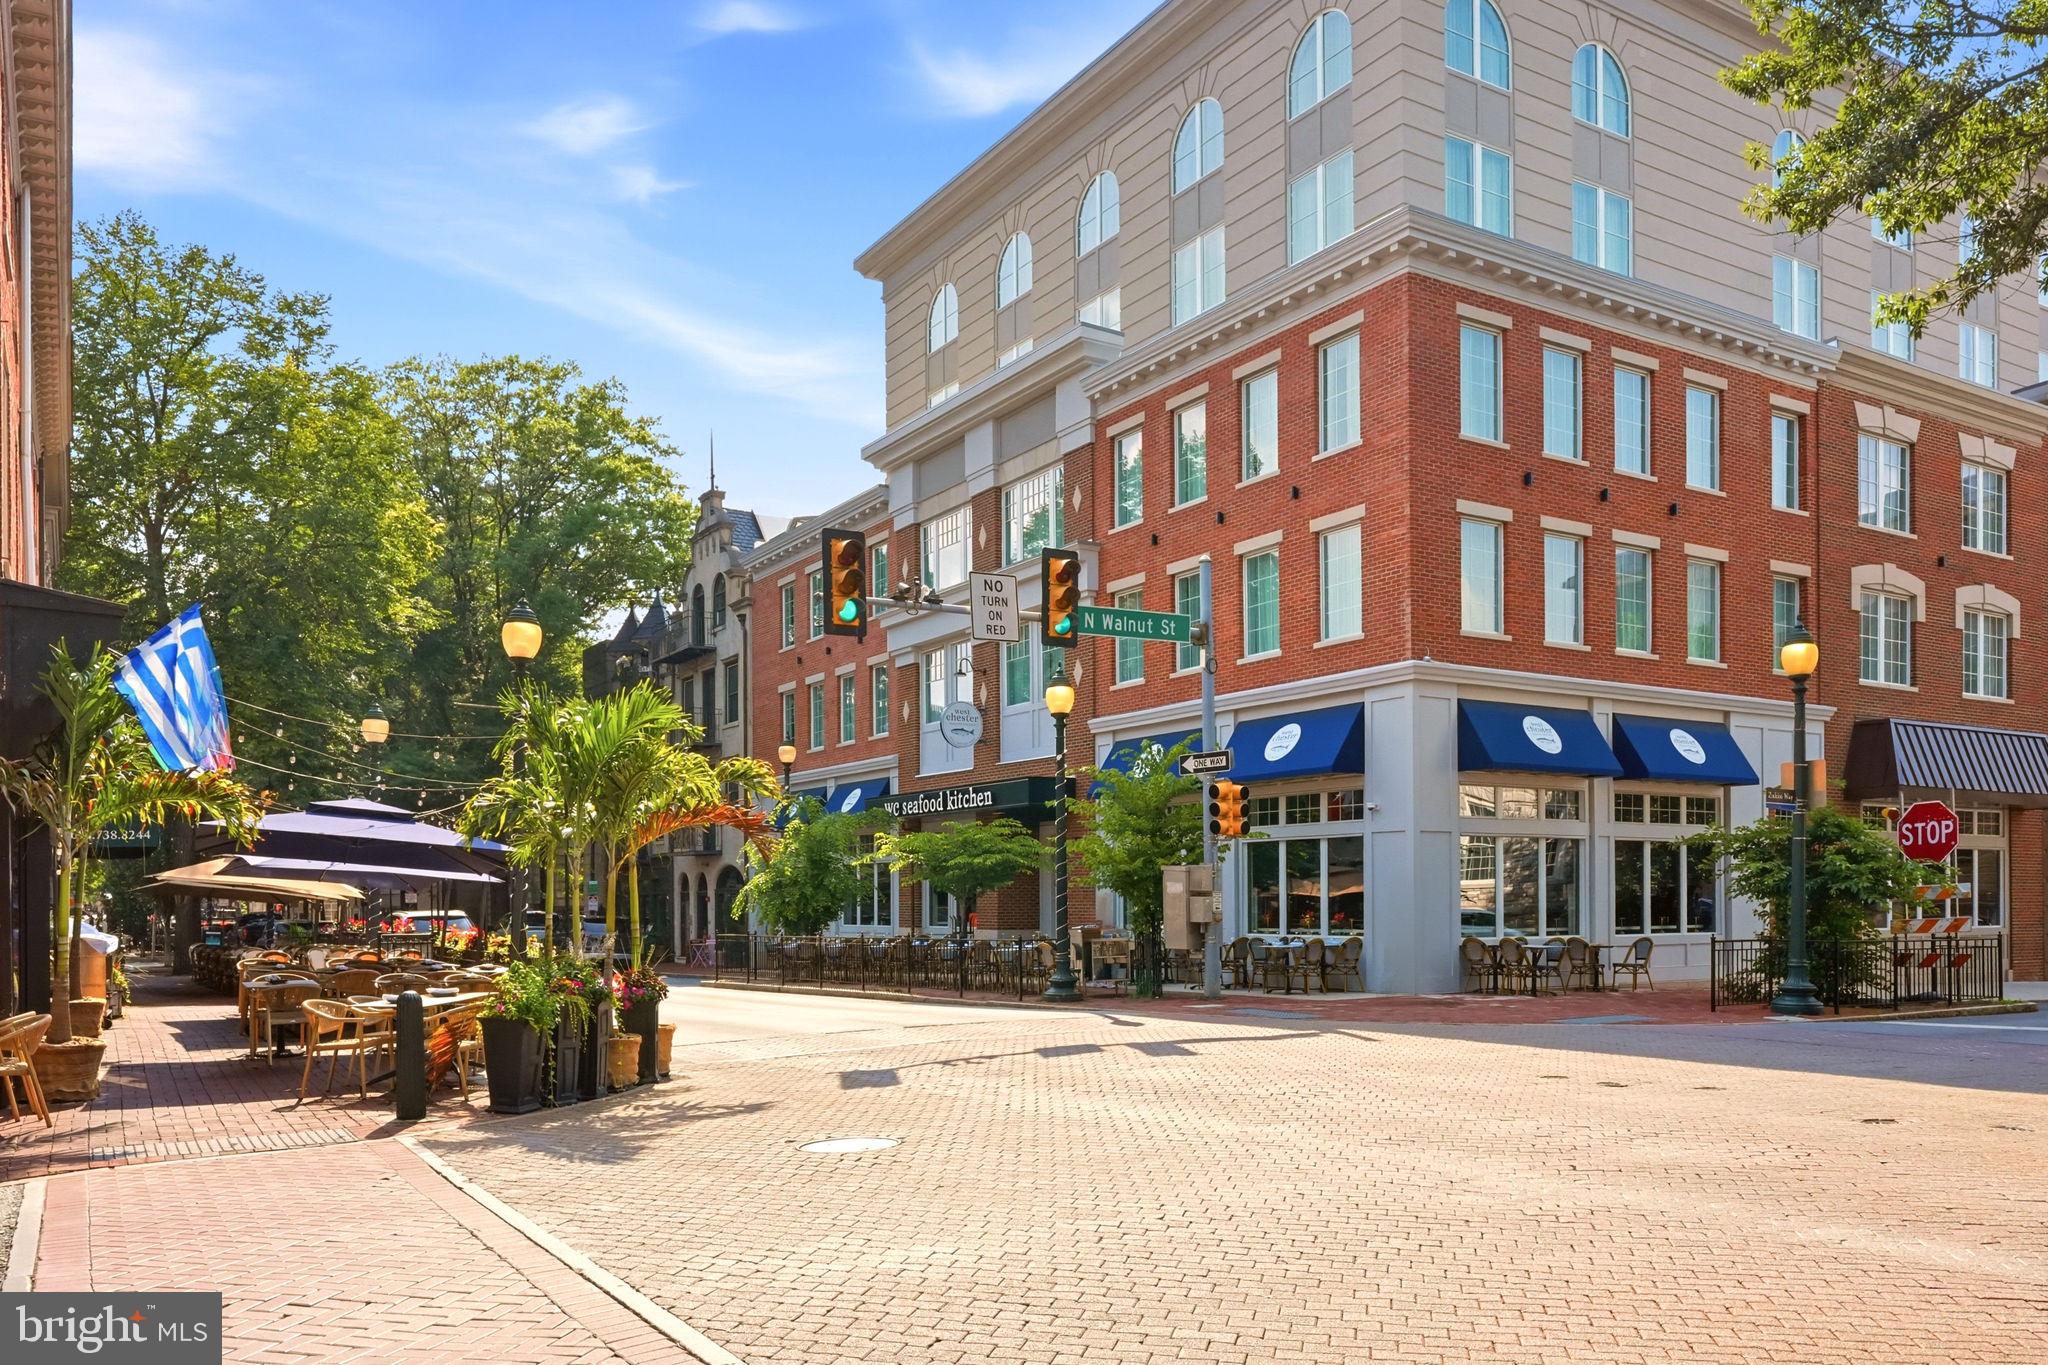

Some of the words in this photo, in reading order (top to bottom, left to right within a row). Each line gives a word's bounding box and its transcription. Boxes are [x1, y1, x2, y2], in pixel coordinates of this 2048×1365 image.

[983, 579, 1003, 592] NO
[981, 595, 1008, 607] TURN
[988, 610, 1003, 621] ON
[986, 624, 1006, 635] RED
[1084, 612, 1095, 629] N
[1102, 613, 1153, 634] Walnut
[1160, 619, 1176, 636] St
[945, 712, 979, 723] chester
[1193, 759, 1208, 768] ONE
[1209, 756, 1224, 766] WAY
[902, 793, 943, 814] seafood
[946, 786, 992, 811] kitchen
[1901, 820, 1953, 846] STOP
